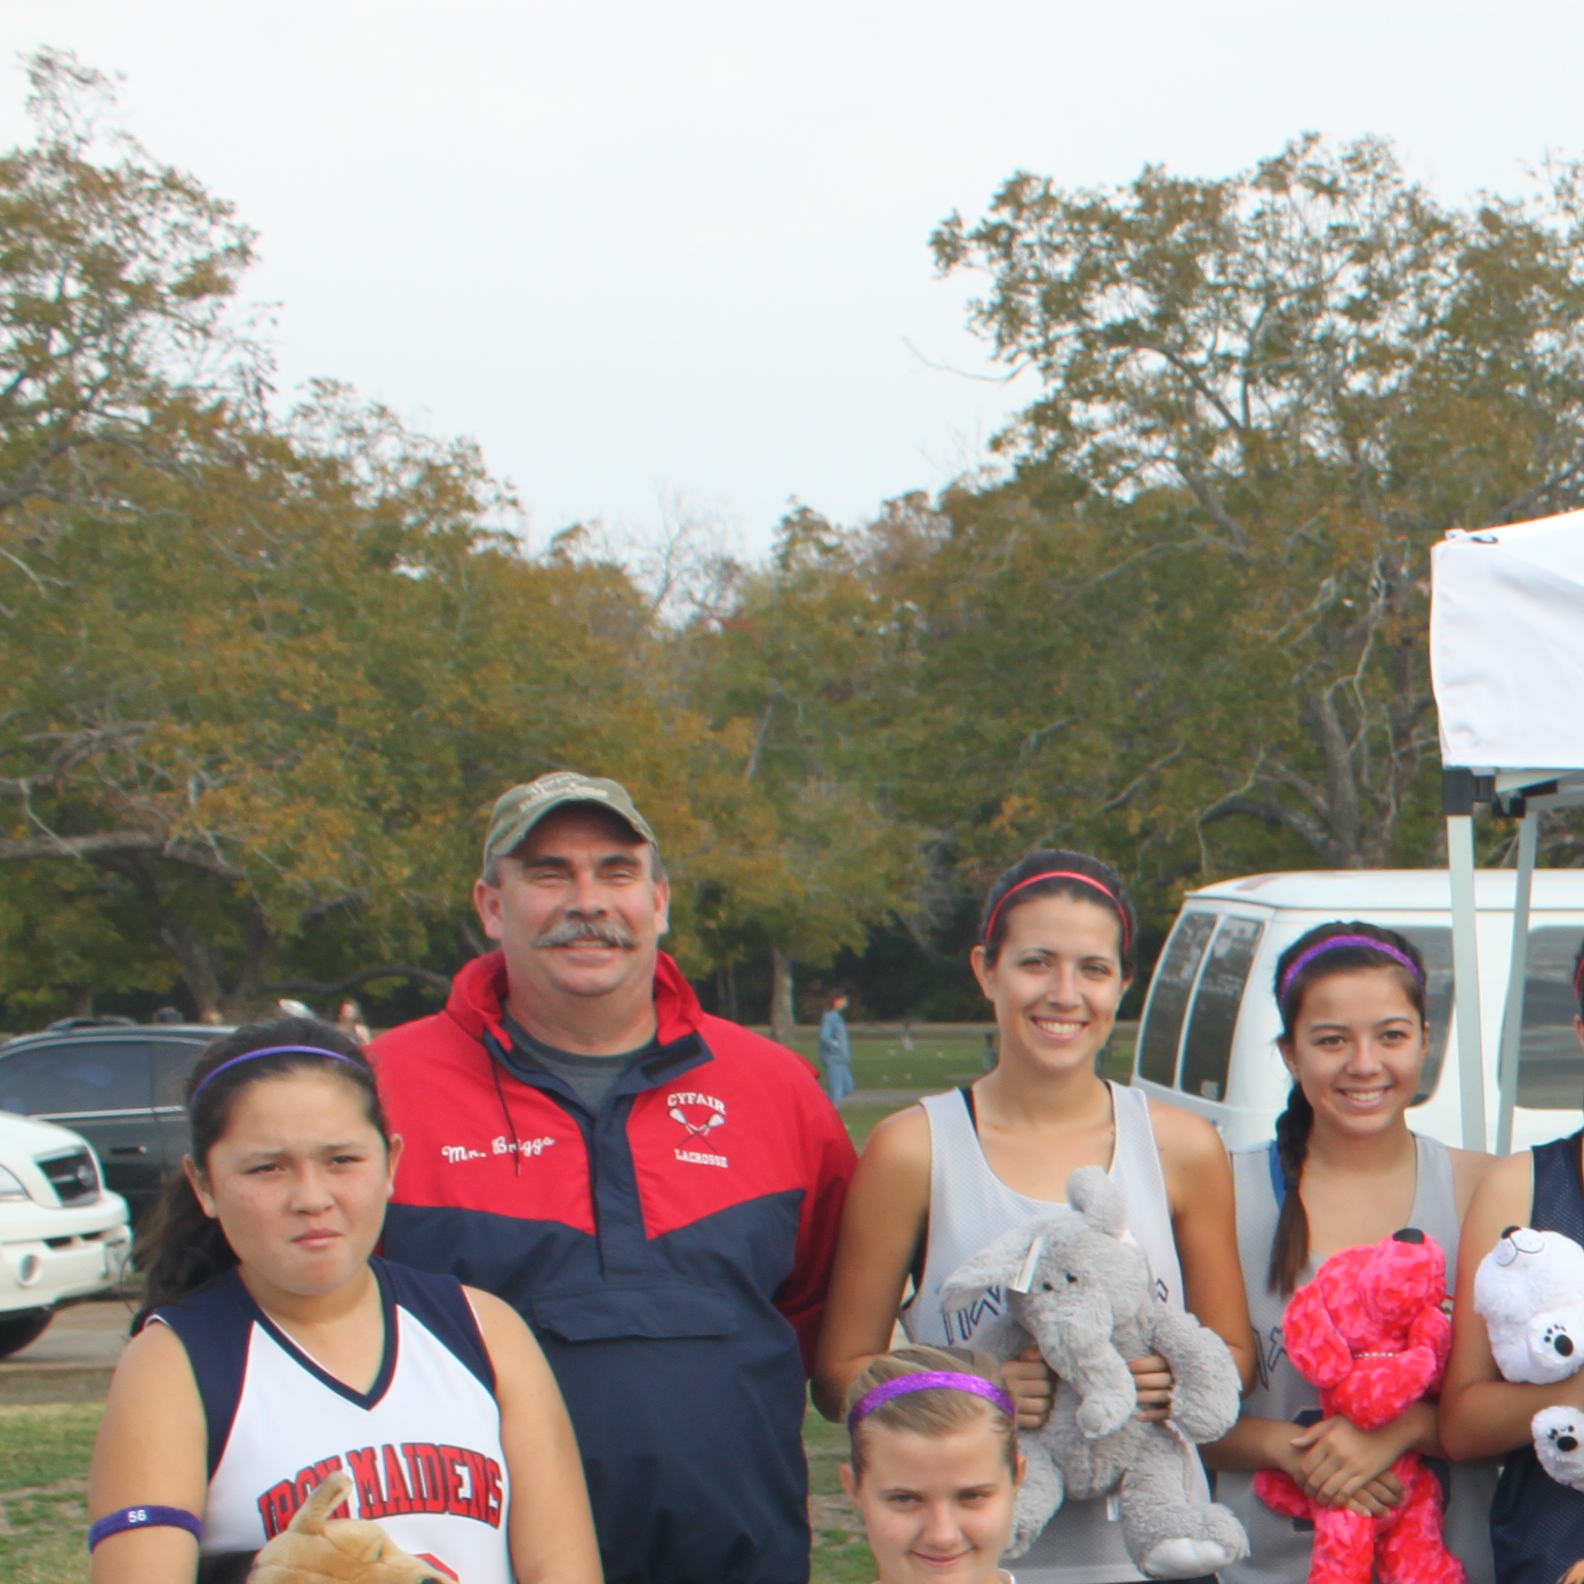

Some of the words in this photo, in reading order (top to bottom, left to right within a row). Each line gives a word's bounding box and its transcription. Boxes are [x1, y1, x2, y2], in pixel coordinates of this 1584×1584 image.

[667, 1092, 727, 1115] CYFAIR
[492, 1135, 556, 1157] Briggs
[674, 1148, 729, 1168] LACROSSE
[346, 1442, 505, 1530] MAIDENS
[127, 1509, 147, 1523] 56
